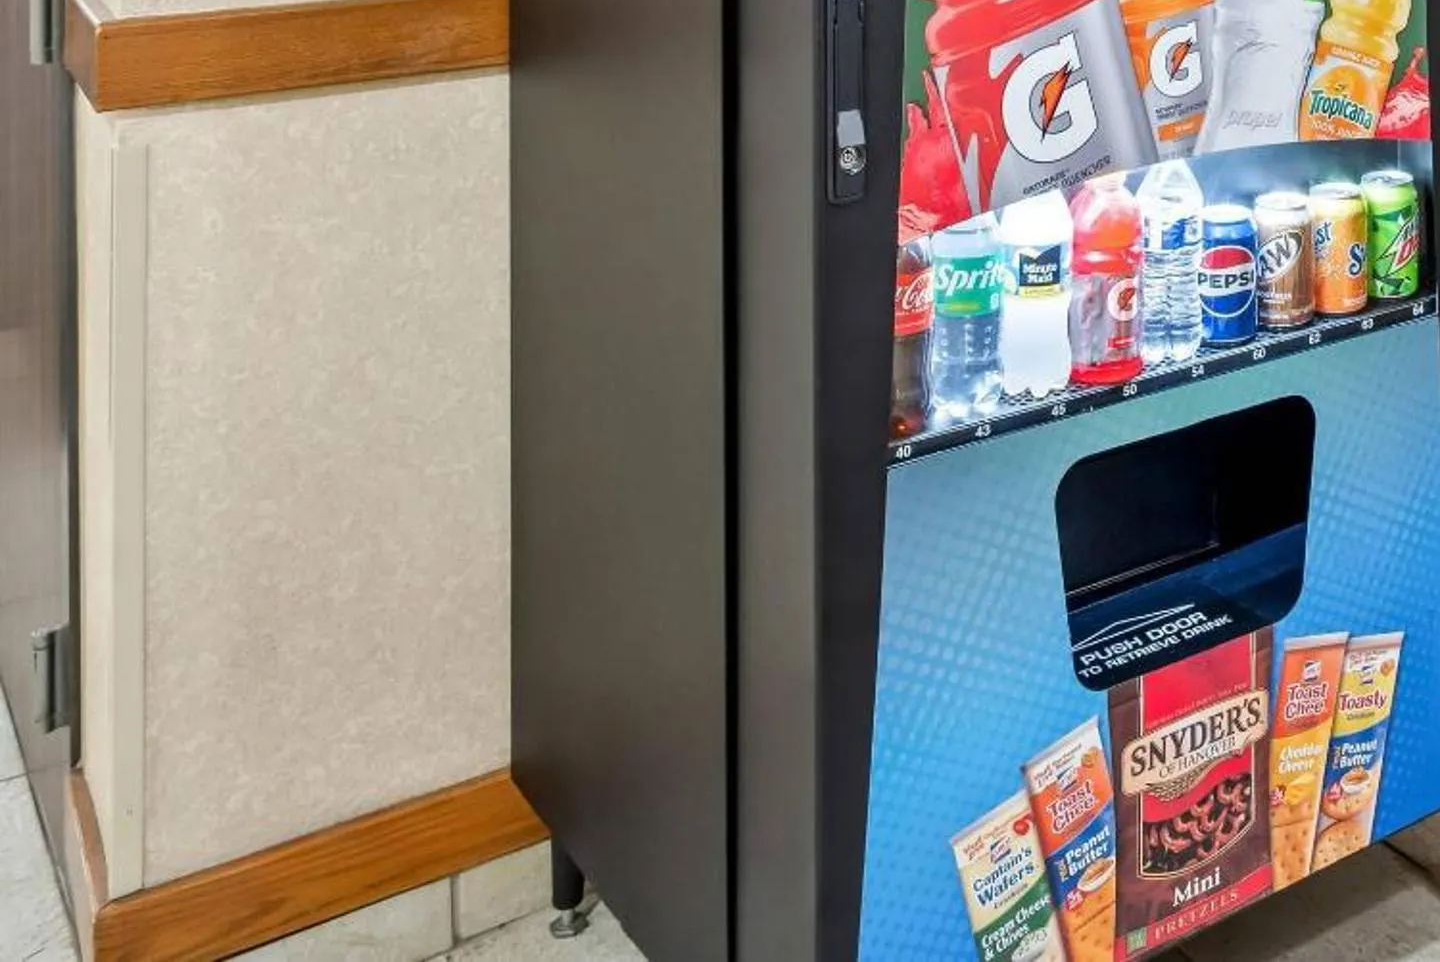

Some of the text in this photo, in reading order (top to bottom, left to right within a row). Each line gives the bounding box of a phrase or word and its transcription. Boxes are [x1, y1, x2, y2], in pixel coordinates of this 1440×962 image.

[1150, 19, 1204, 98] G
[1002, 33, 1098, 163] G
[1309, 90, 1374, 130] Tropicana
[936, 260, 1007, 296] Sprit
[1197, 270, 1255, 289] PEPSI
[1122, 385, 1138, 397] 50
[974, 424, 992, 438] 43
[1078, 614, 1234, 679] TO RETRIEVE DRINK
[1080, 611, 1207, 666] PUSH DOOR
[1285, 701, 1324, 720] Chee
[1288, 684, 1327, 701] Toast
[1340, 689, 1387, 712] Toasty
[1130, 696, 1262, 777] SNYDER'S
[1159, 737, 1236, 778] OF HANOVER
[1048, 782, 1092, 817] Toast
[1053, 800, 1095, 832] Chee
[1065, 826, 1111, 863] Peanut
[1068, 841, 1109, 877] Butter
[973, 846, 1033, 891] Captain's
[977, 863, 1035, 906] Wafers
[1172, 866, 1222, 907] Mini
[982, 895, 1051, 949] Cream Cheese
[1154, 890, 1239, 941] PRETZELS
